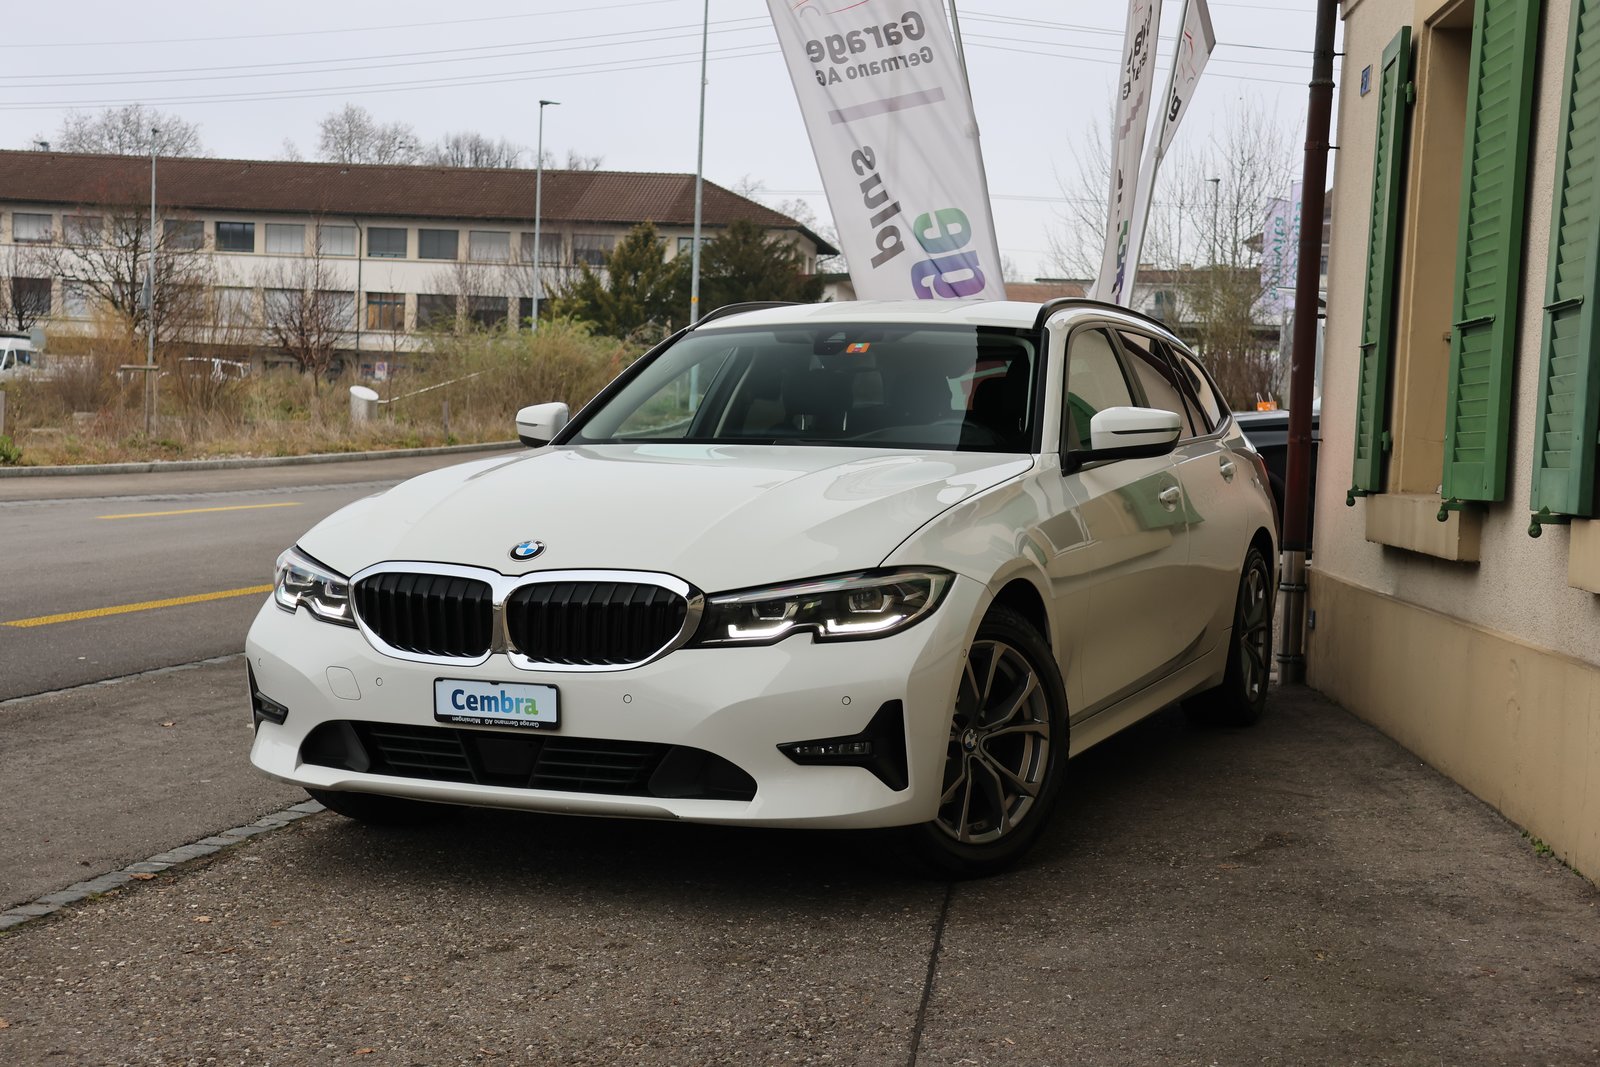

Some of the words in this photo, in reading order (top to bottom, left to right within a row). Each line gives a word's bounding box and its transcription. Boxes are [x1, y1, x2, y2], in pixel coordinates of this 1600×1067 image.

[451, 688, 539, 715] Cembra
[494, 719, 518, 727] Germano
[519, 720, 539, 728] Garage
